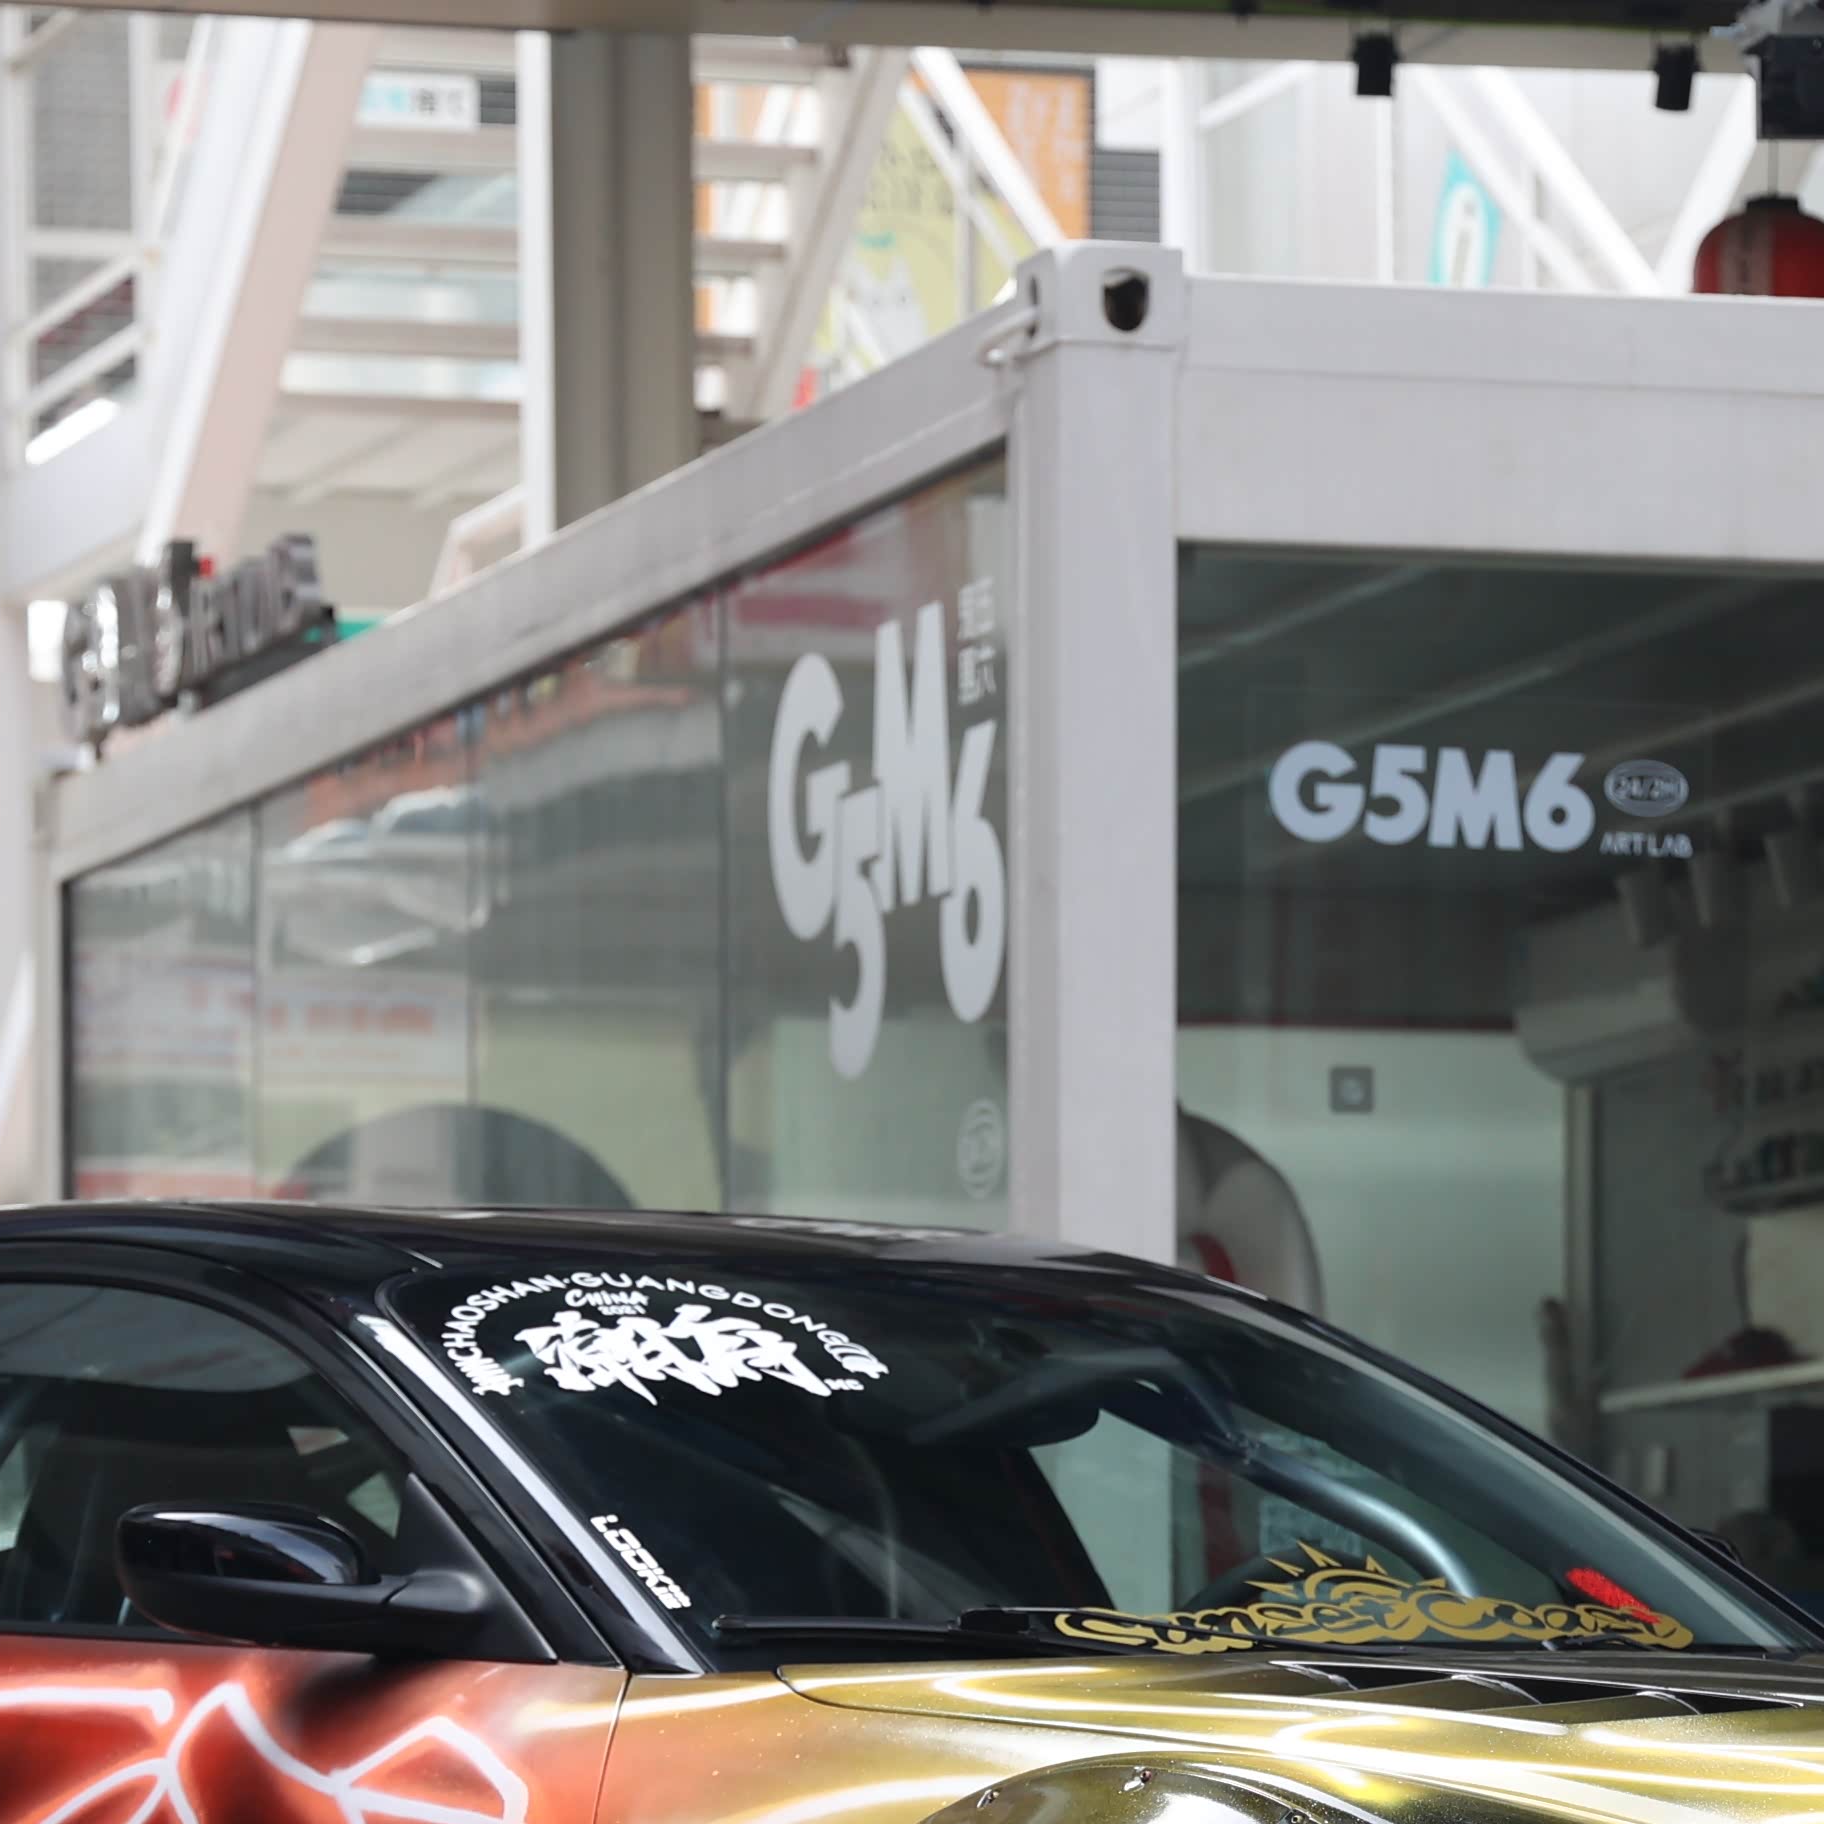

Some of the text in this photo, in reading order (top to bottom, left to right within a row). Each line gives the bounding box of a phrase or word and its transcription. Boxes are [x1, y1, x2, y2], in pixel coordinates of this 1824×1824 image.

[1268, 740, 1596, 853] G5M6
[1600, 831, 1694, 859] ART LAB
[564, 1288, 650, 1308] CHINA
